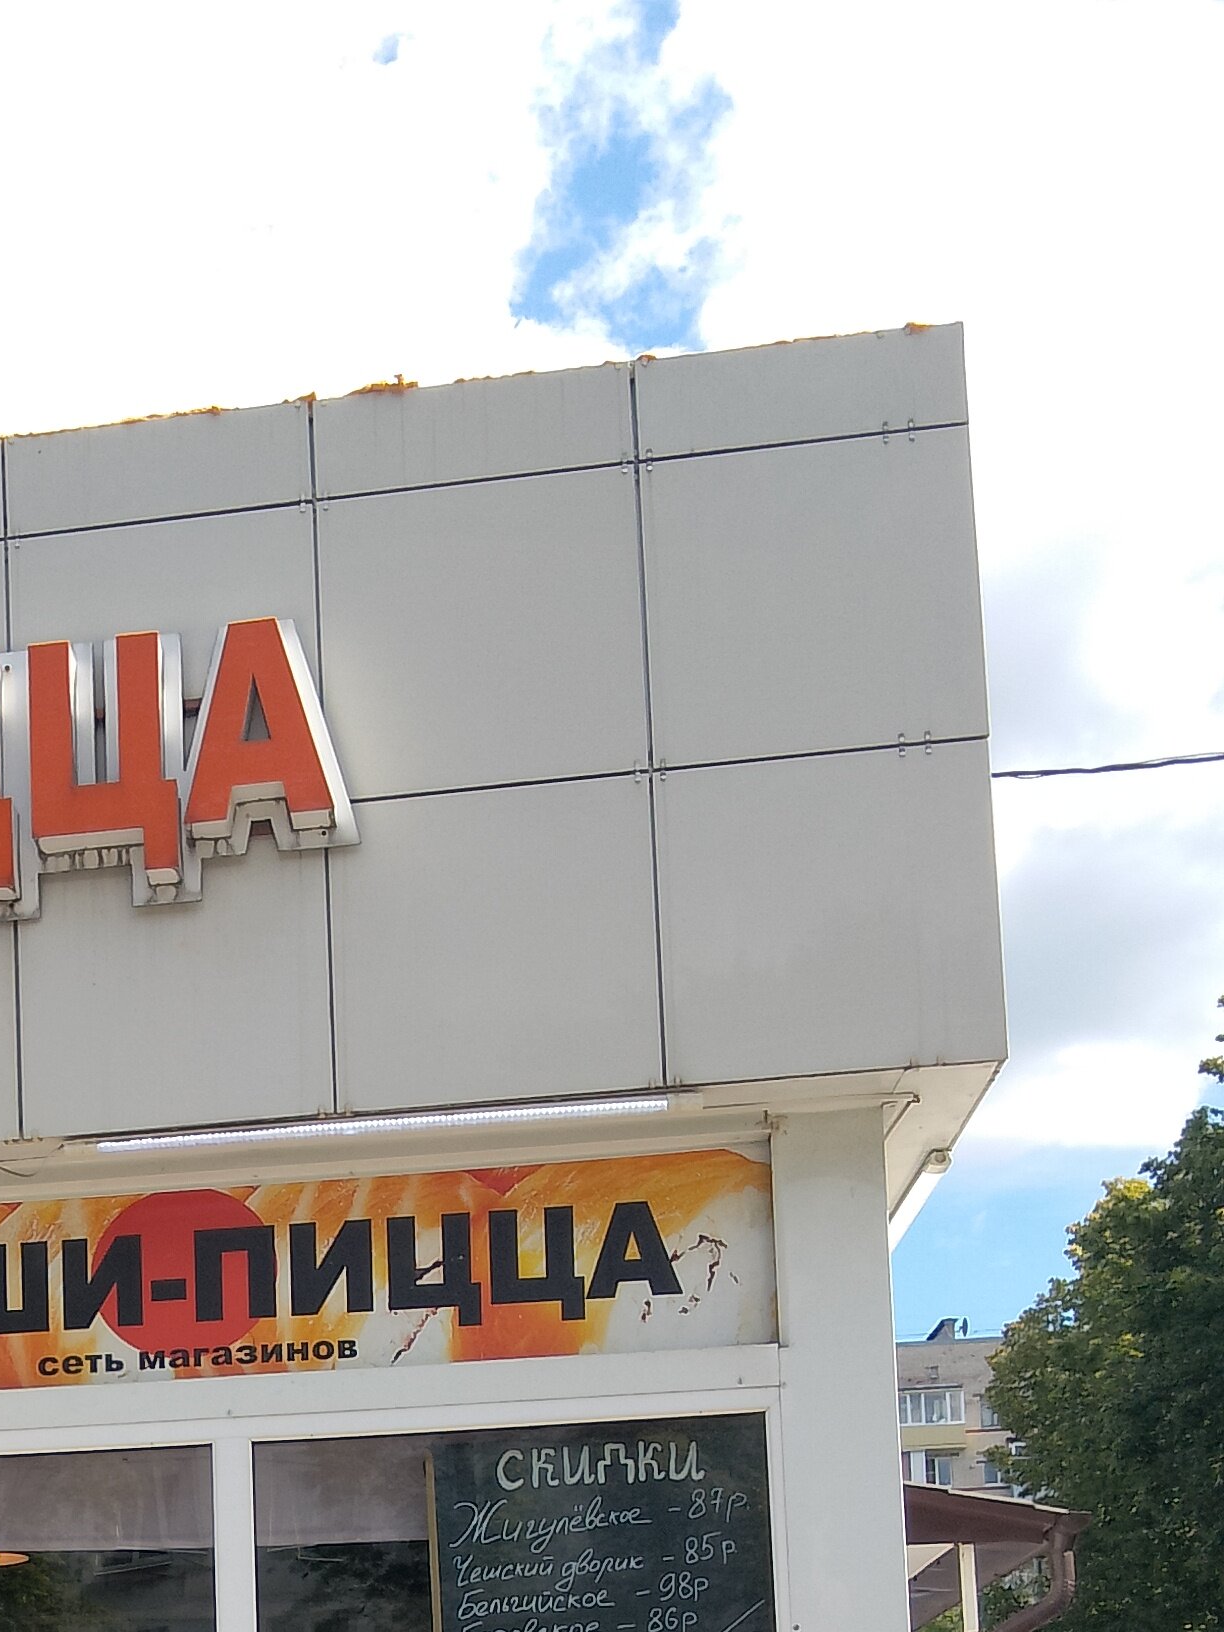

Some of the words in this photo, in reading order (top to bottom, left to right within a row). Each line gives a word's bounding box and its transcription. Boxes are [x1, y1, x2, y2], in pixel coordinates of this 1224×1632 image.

[37, 1353, 125, 1376] сеть
[138, 1339, 359, 1371] магазинов
[453, 1555, 554, 1588] Чешский
[555, 1549, 645, 1592] дворик
[457, 1588, 616, 1620] Бельгийское
